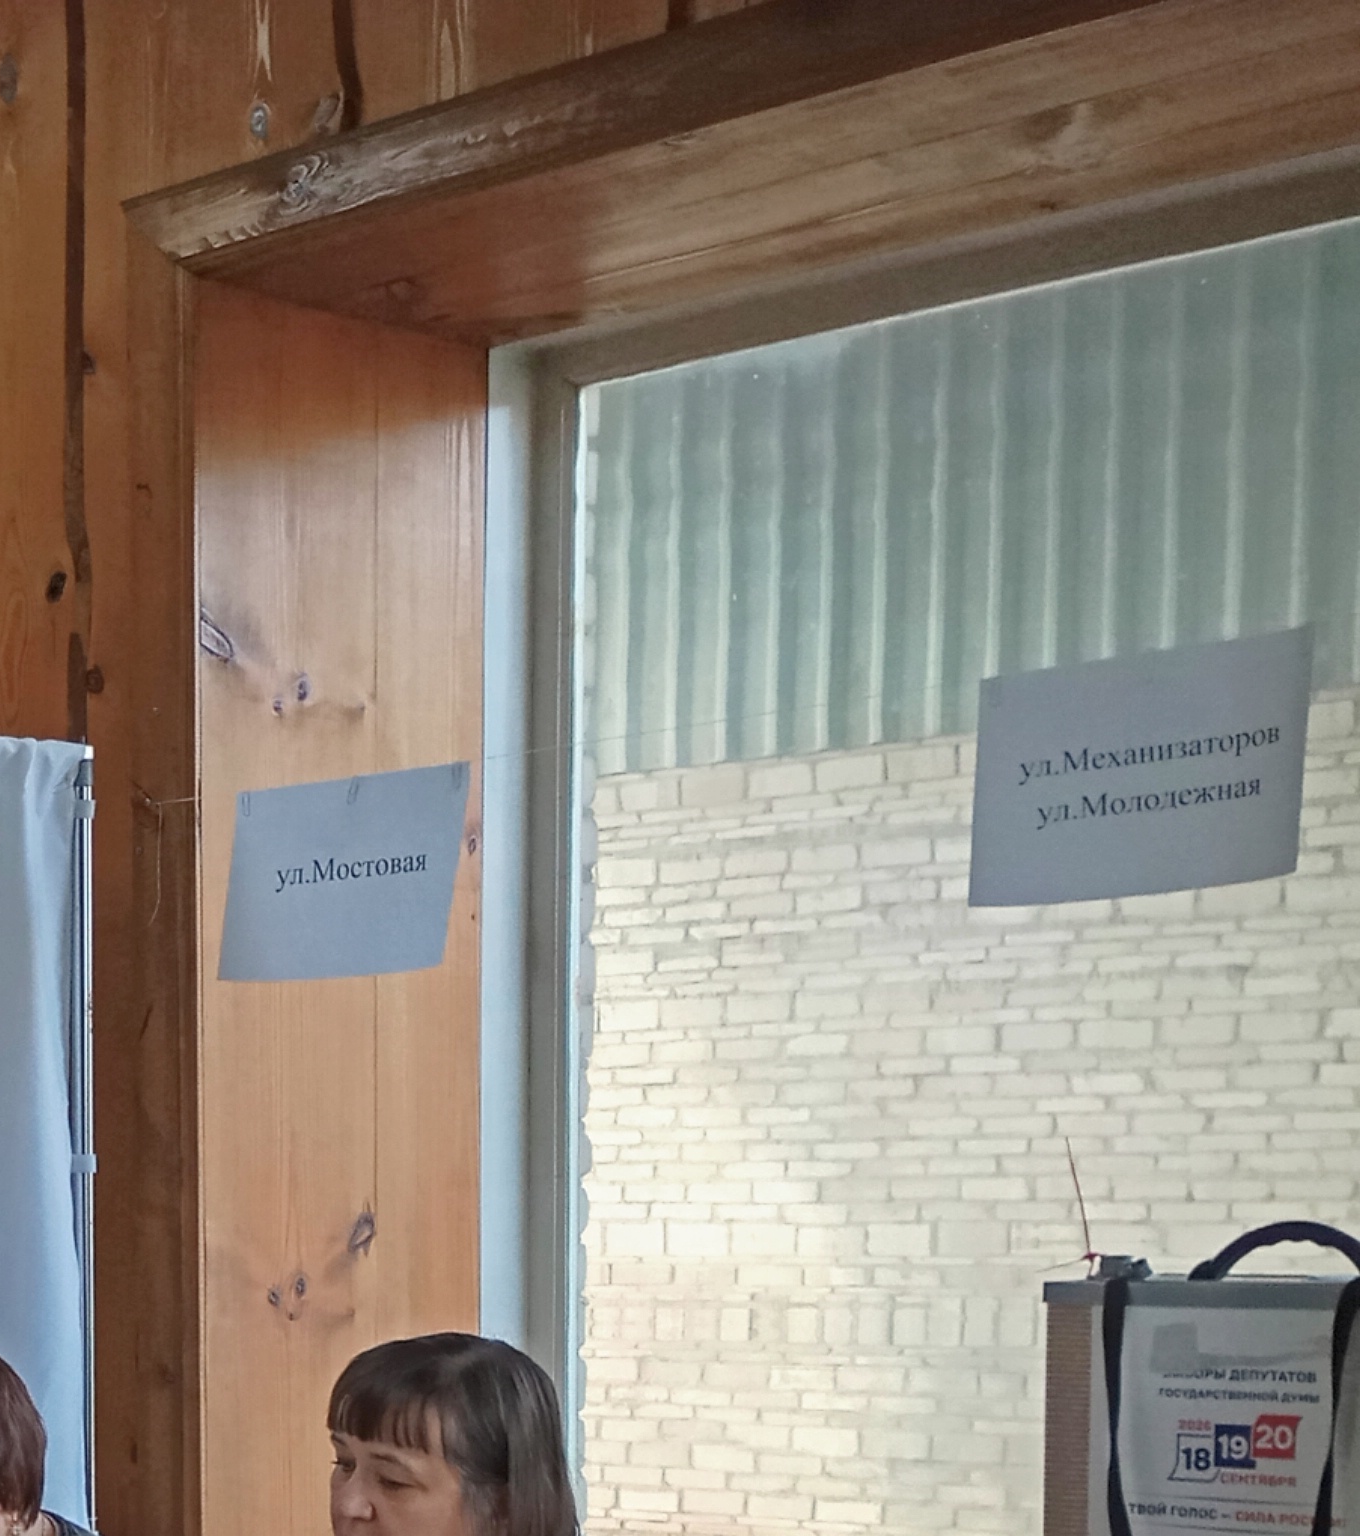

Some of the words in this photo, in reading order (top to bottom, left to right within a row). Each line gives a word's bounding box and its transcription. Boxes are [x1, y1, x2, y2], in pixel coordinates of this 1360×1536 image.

[1018, 726, 1281, 785] ул.Механизаторов
[1036, 778, 1261, 830] ул.Молодежная
[275, 854, 428, 893] ул.Мостовая
[1163, 1368, 1226, 1379] ОРЫ
[1228, 1369, 1318, 1383] ДЕПУТАТОВ
[1158, 1387, 1279, 1402] ГОСУДАРСТВЕННОЙ
[1280, 1392, 1321, 1404] ДУМЫ
[1178, 1419, 1212, 1430] 2026
[1182, 1448, 1211, 1471] 18
[1218, 1434, 1248, 1459] 19
[1255, 1424, 1293, 1449] 20
[1220, 1473, 1297, 1487] СЕНТЯБРЯ
[1130, 1502, 1167, 1516] ТВОЙ
[1170, 1506, 1217, 1520] ГОЛОС
[1236, 1510, 1275, 1524] СИЛА
